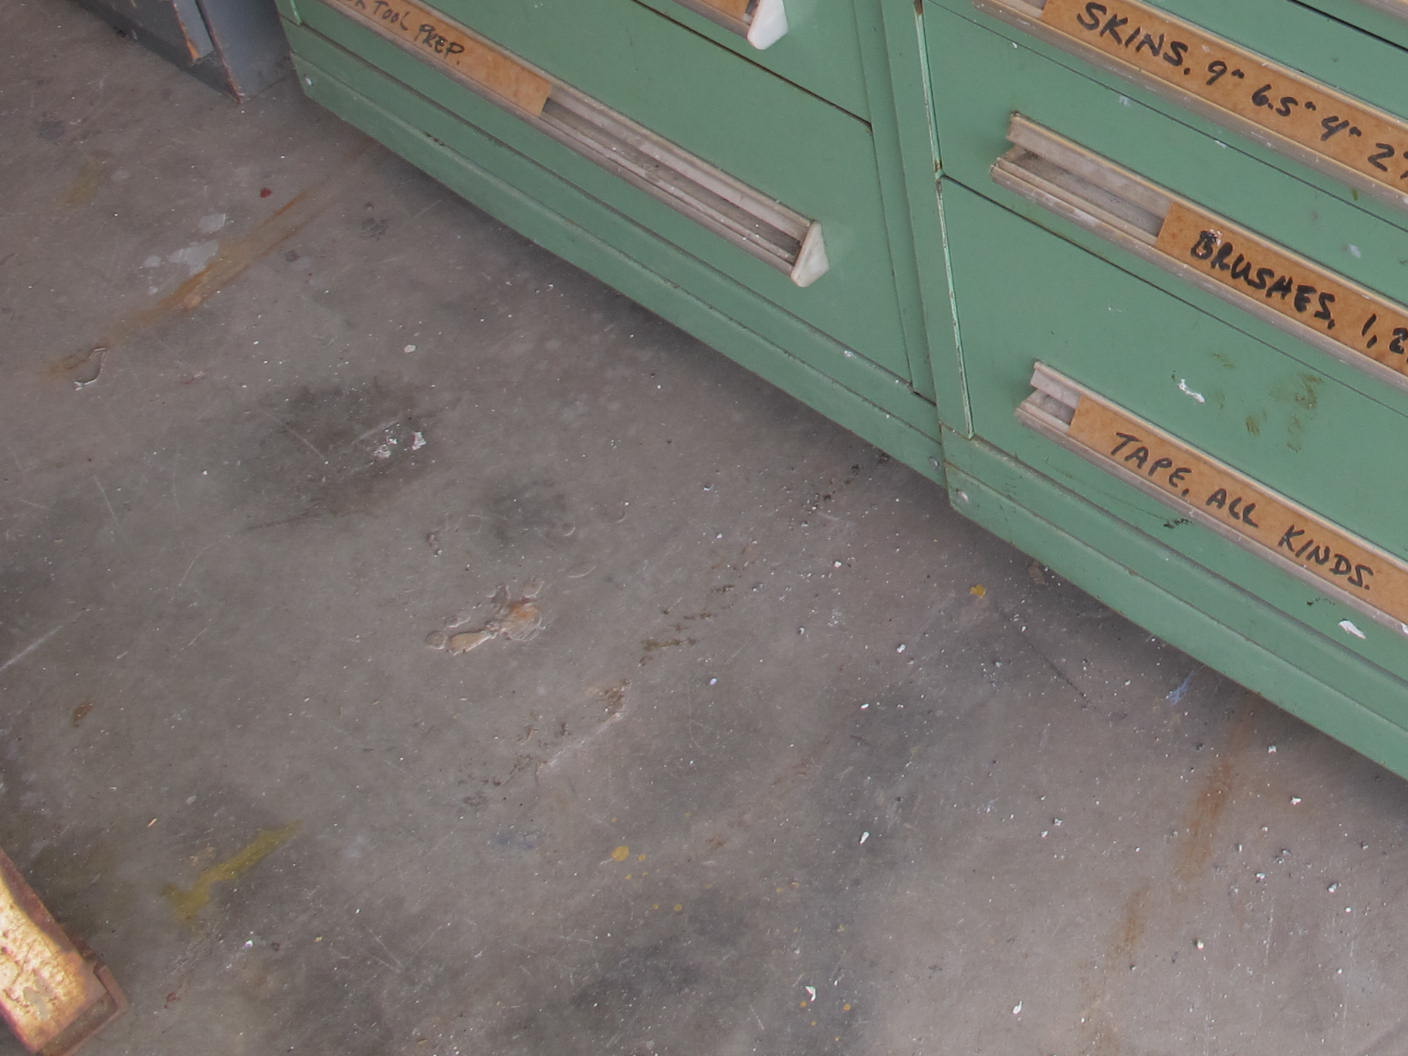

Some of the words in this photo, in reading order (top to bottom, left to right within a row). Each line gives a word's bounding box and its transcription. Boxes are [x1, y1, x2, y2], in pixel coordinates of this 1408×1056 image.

[1076, 2, 1191, 76] SKINS.
[1206, 488, 1259, 528] ALL
[1277, 524, 1374, 591] KINDS.
